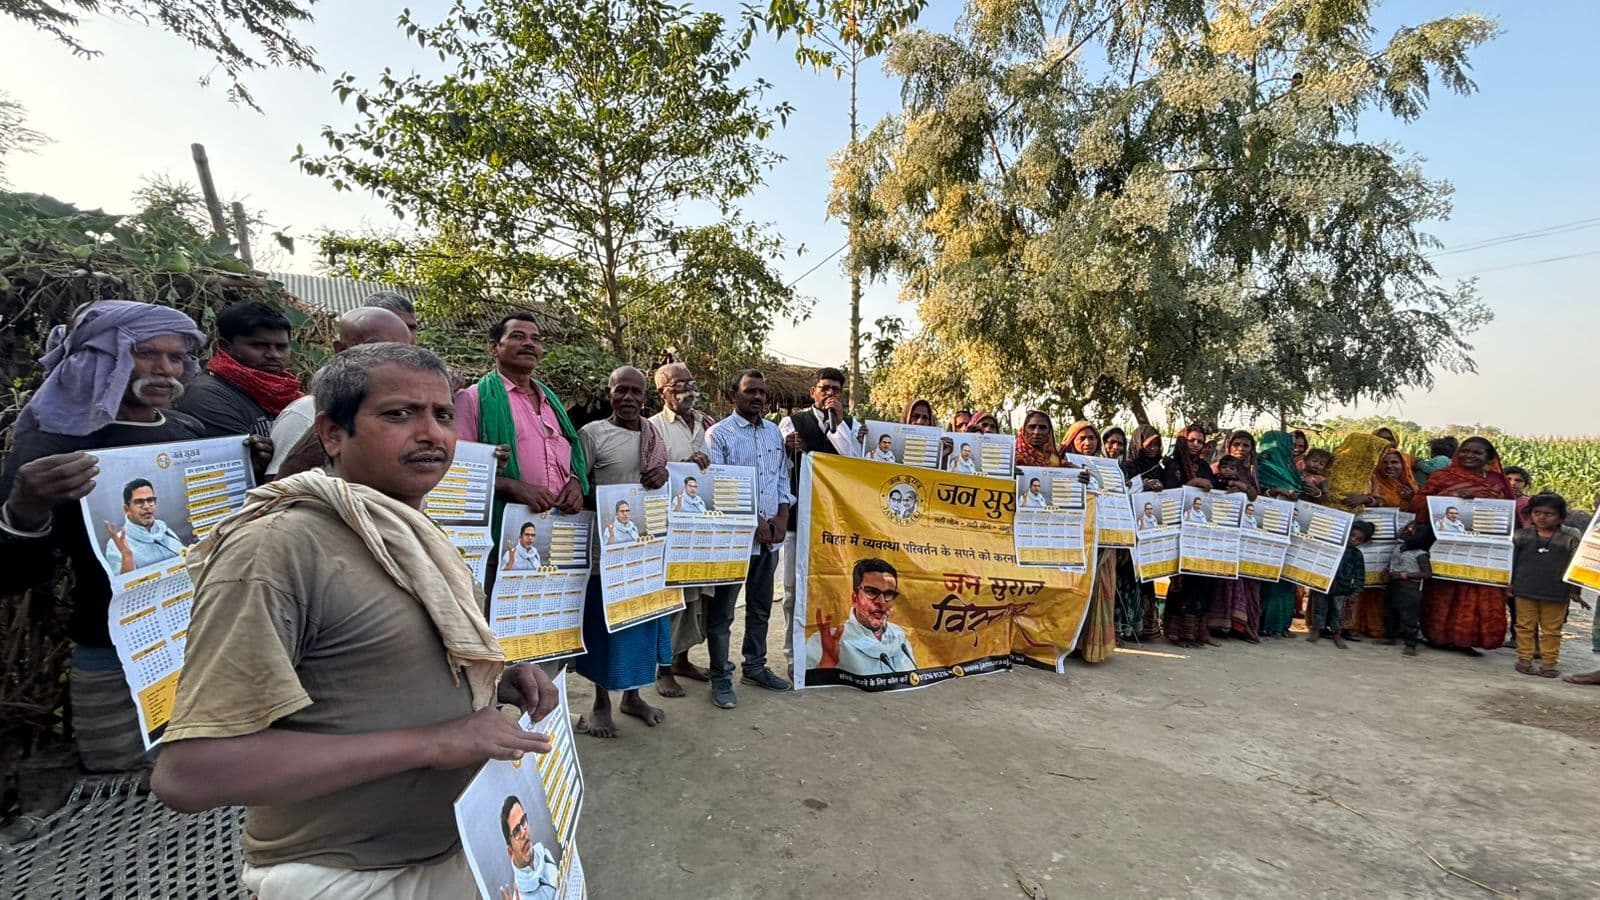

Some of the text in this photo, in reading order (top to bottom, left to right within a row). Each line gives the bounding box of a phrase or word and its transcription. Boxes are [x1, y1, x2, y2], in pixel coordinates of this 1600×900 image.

[937, 482, 980, 508] जन
[822, 531, 847, 545] बिहार
[849, 534, 861, 546] में
[862, 537, 899, 552] व्यवस्था
[902, 540, 938, 556] परिवर्तन
[941, 544, 951, 556] के
[954, 546, 975, 560] सपने
[978, 549, 991, 561] को
[943, 573, 1045, 601] जन सुराज
